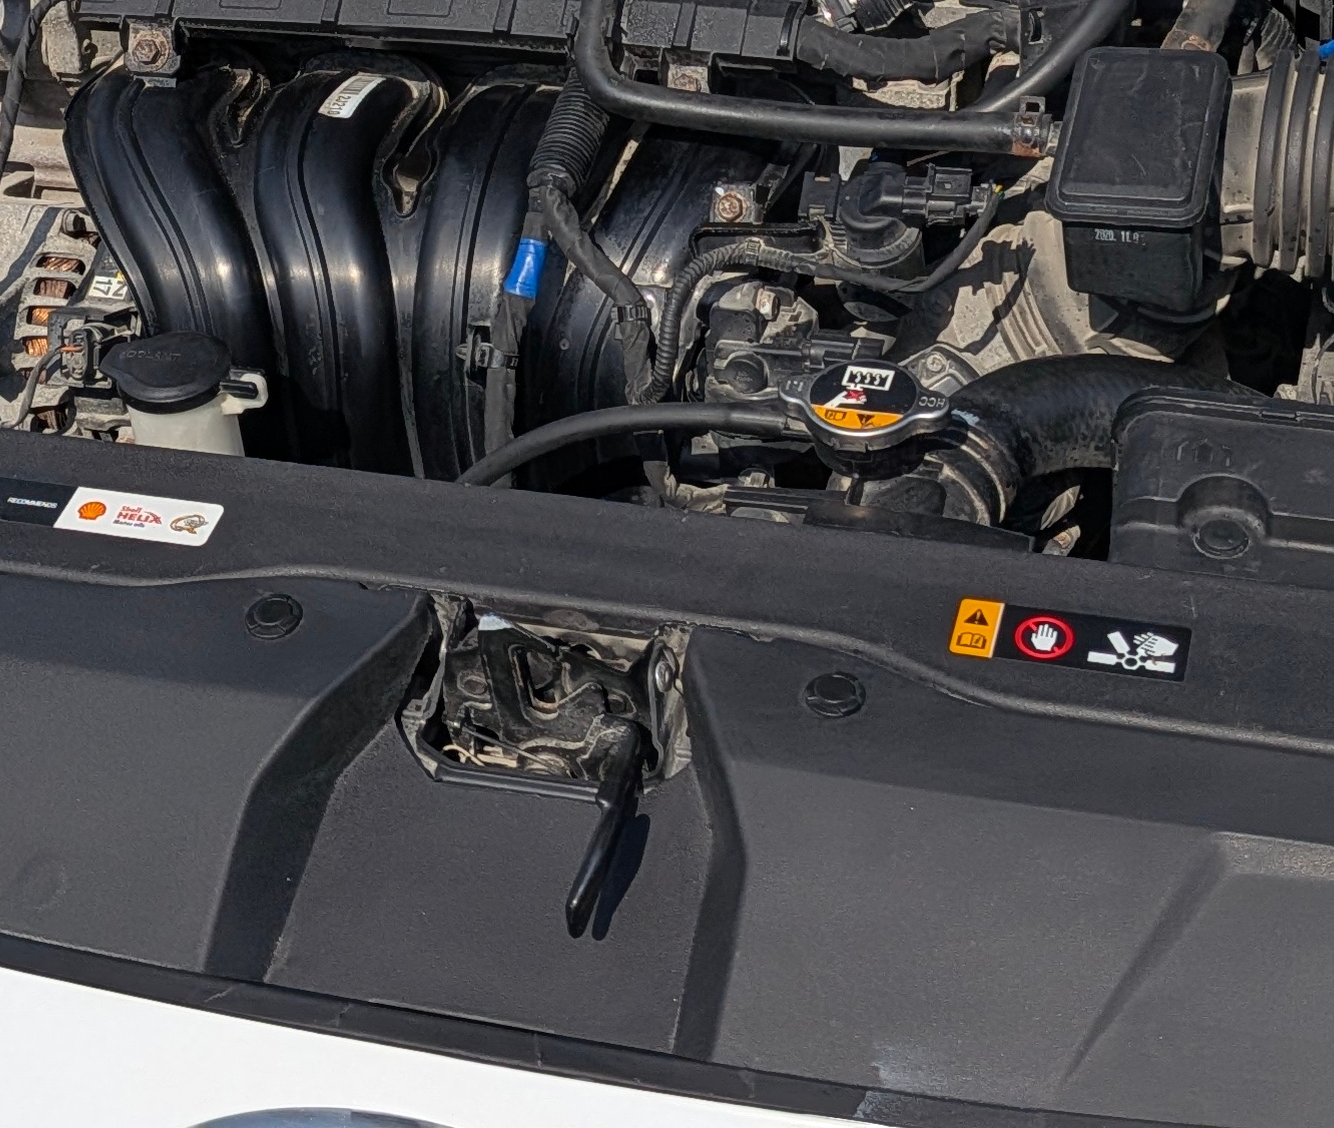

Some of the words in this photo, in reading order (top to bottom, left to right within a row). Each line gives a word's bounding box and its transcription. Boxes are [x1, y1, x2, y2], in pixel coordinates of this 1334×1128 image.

[93, 279, 113, 296] 17
[118, 350, 182, 362] COOLANT
[919, 396, 946, 408] HCC
[7, 496, 58, 508] RECOMMENDS
[121, 505, 142, 514] Shell
[116, 511, 162, 525] HELIX
